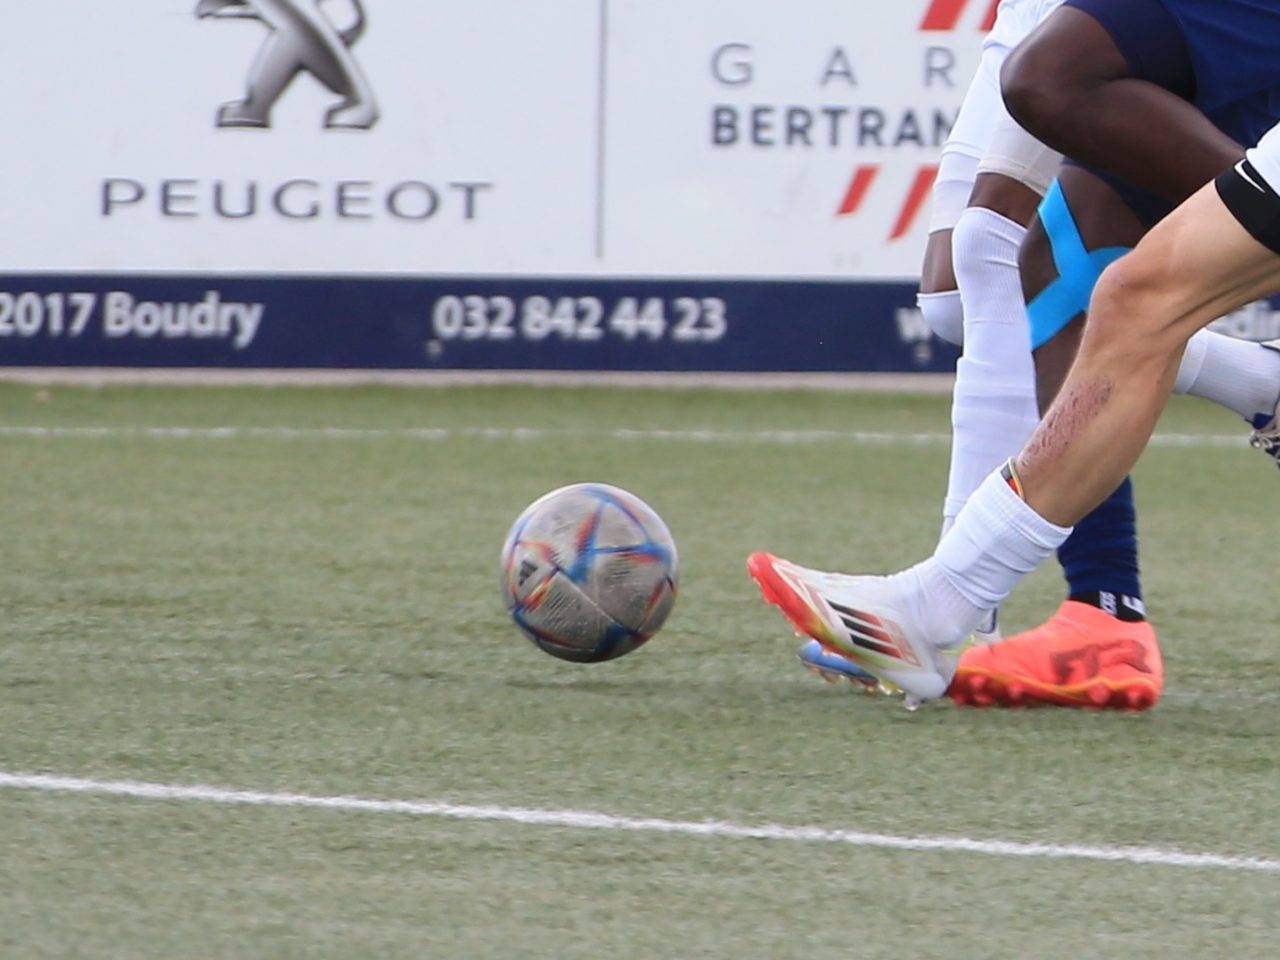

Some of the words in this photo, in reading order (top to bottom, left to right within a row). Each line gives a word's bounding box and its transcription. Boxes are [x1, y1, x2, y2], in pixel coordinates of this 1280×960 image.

[101, 178, 493, 221] PEUGEOT
[0, 292, 96, 337] 2017
[104, 291, 264, 350] Boudry
[433, 295, 515, 339] 032
[521, 295, 604, 339] 842
[609, 297, 666, 339] 44
[673, 297, 727, 340] 23
